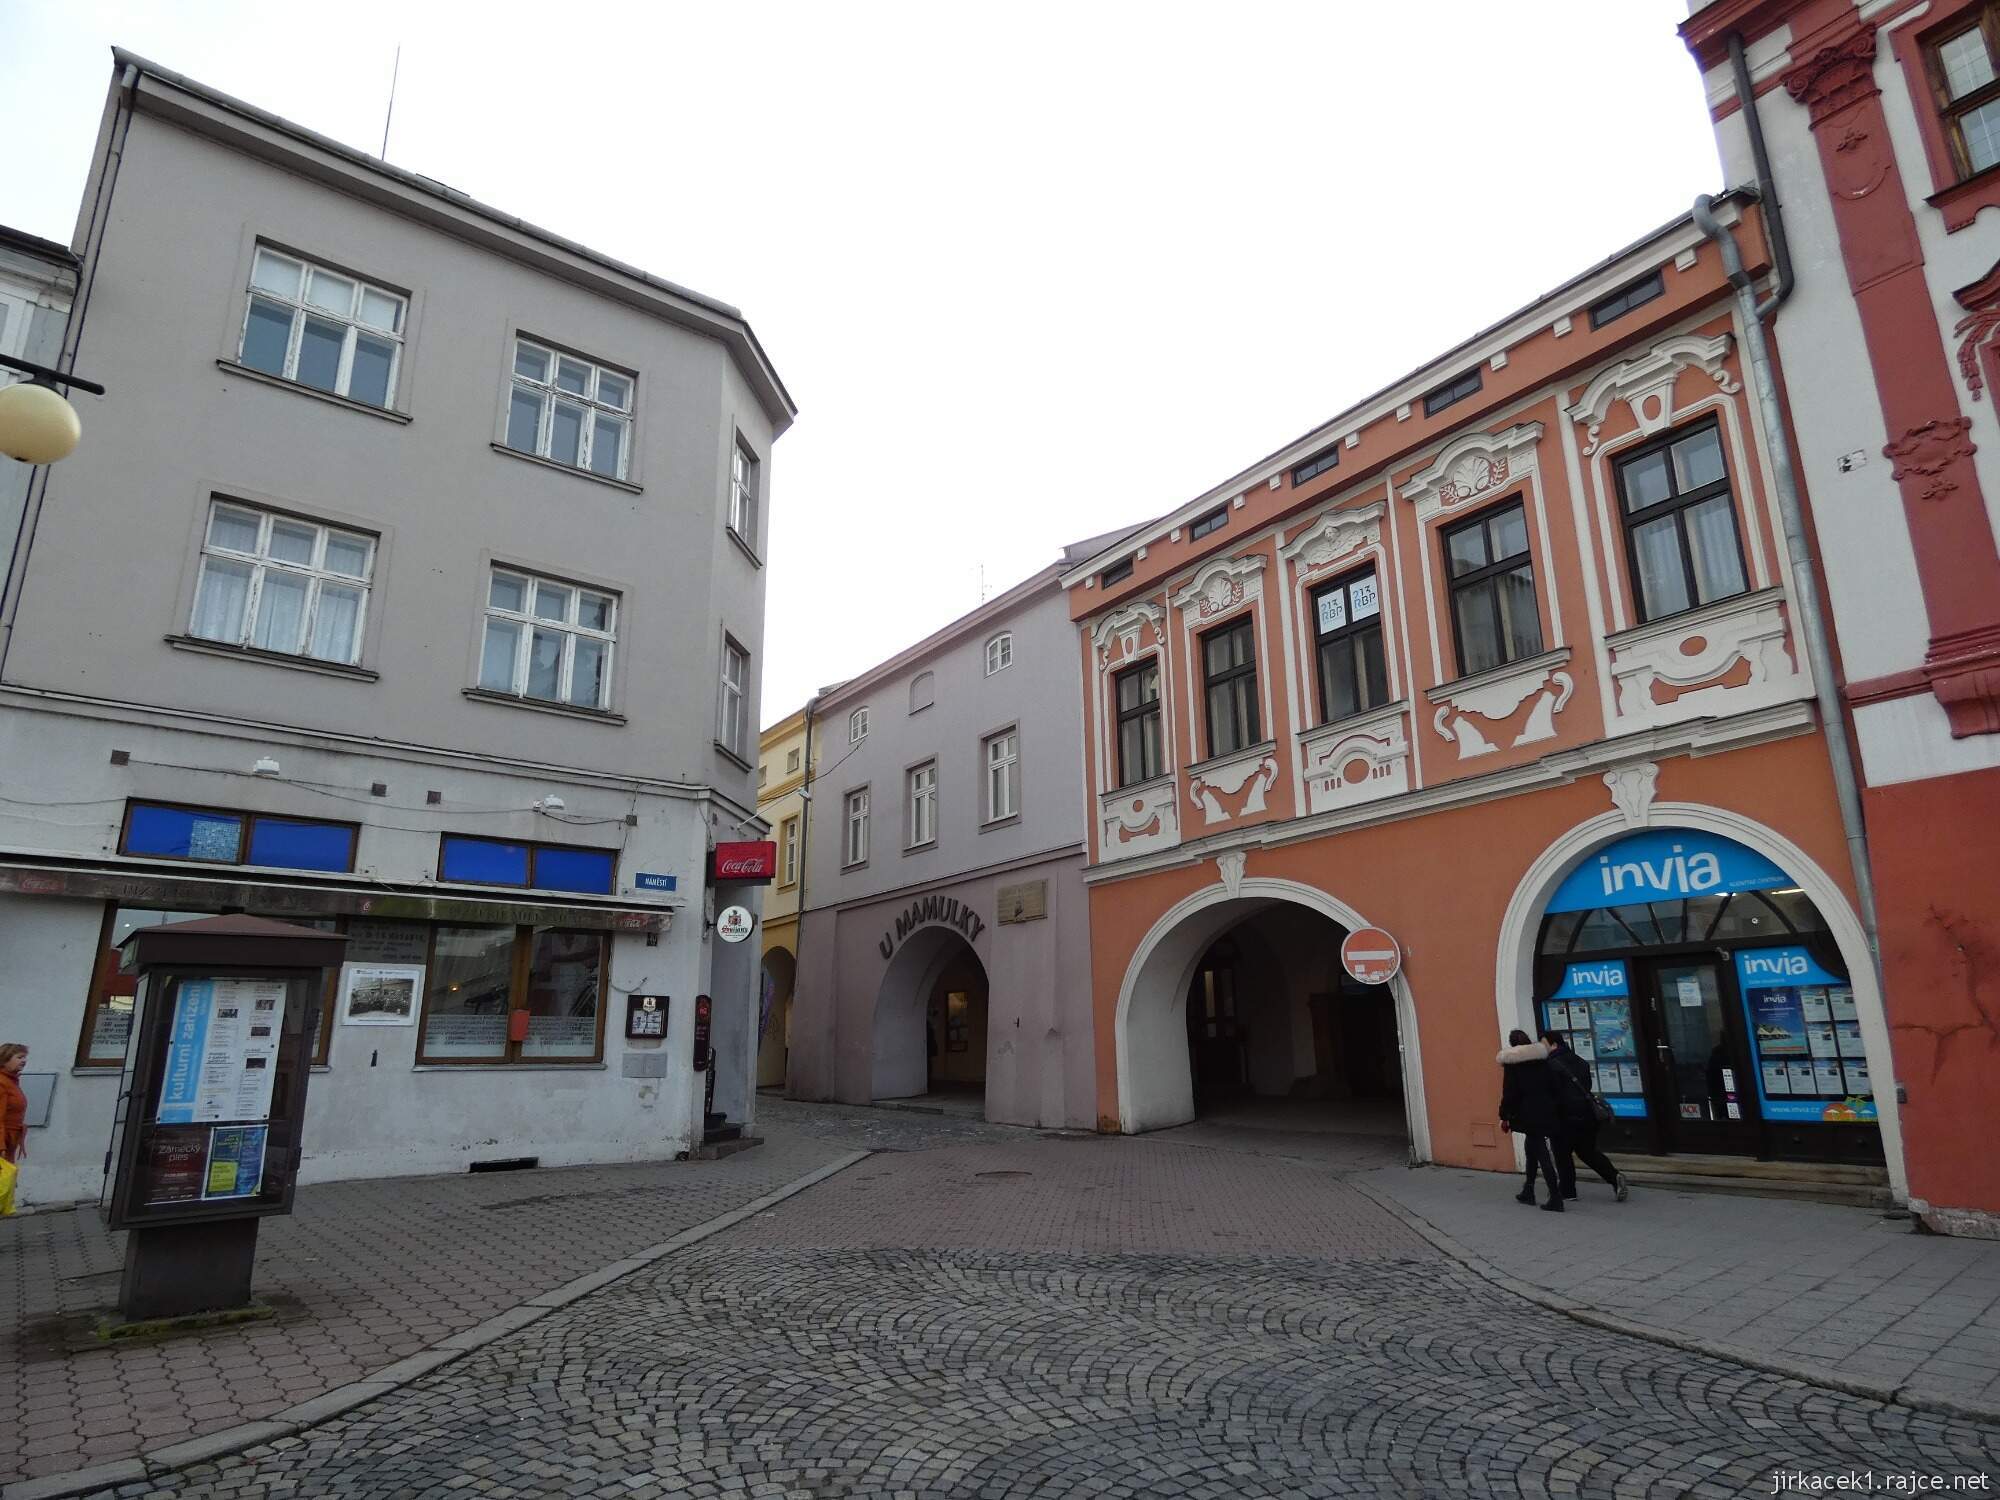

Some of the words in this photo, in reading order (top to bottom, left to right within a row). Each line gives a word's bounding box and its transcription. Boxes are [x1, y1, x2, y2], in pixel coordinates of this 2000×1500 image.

[1354, 593, 1376, 609] RBP
[1322, 605, 1343, 621] RBP
[644, 876, 668, 887] NÁMĚSTÍ
[1600, 845, 1721, 896] invia
[878, 932, 894, 960] U
[895, 895, 986, 942] MAMULKY
[1744, 951, 1808, 976] invia
[1572, 964, 1623, 987] invia
[1763, 994, 1787, 1003] invia
[168, 1043, 192, 1100] kulturní
